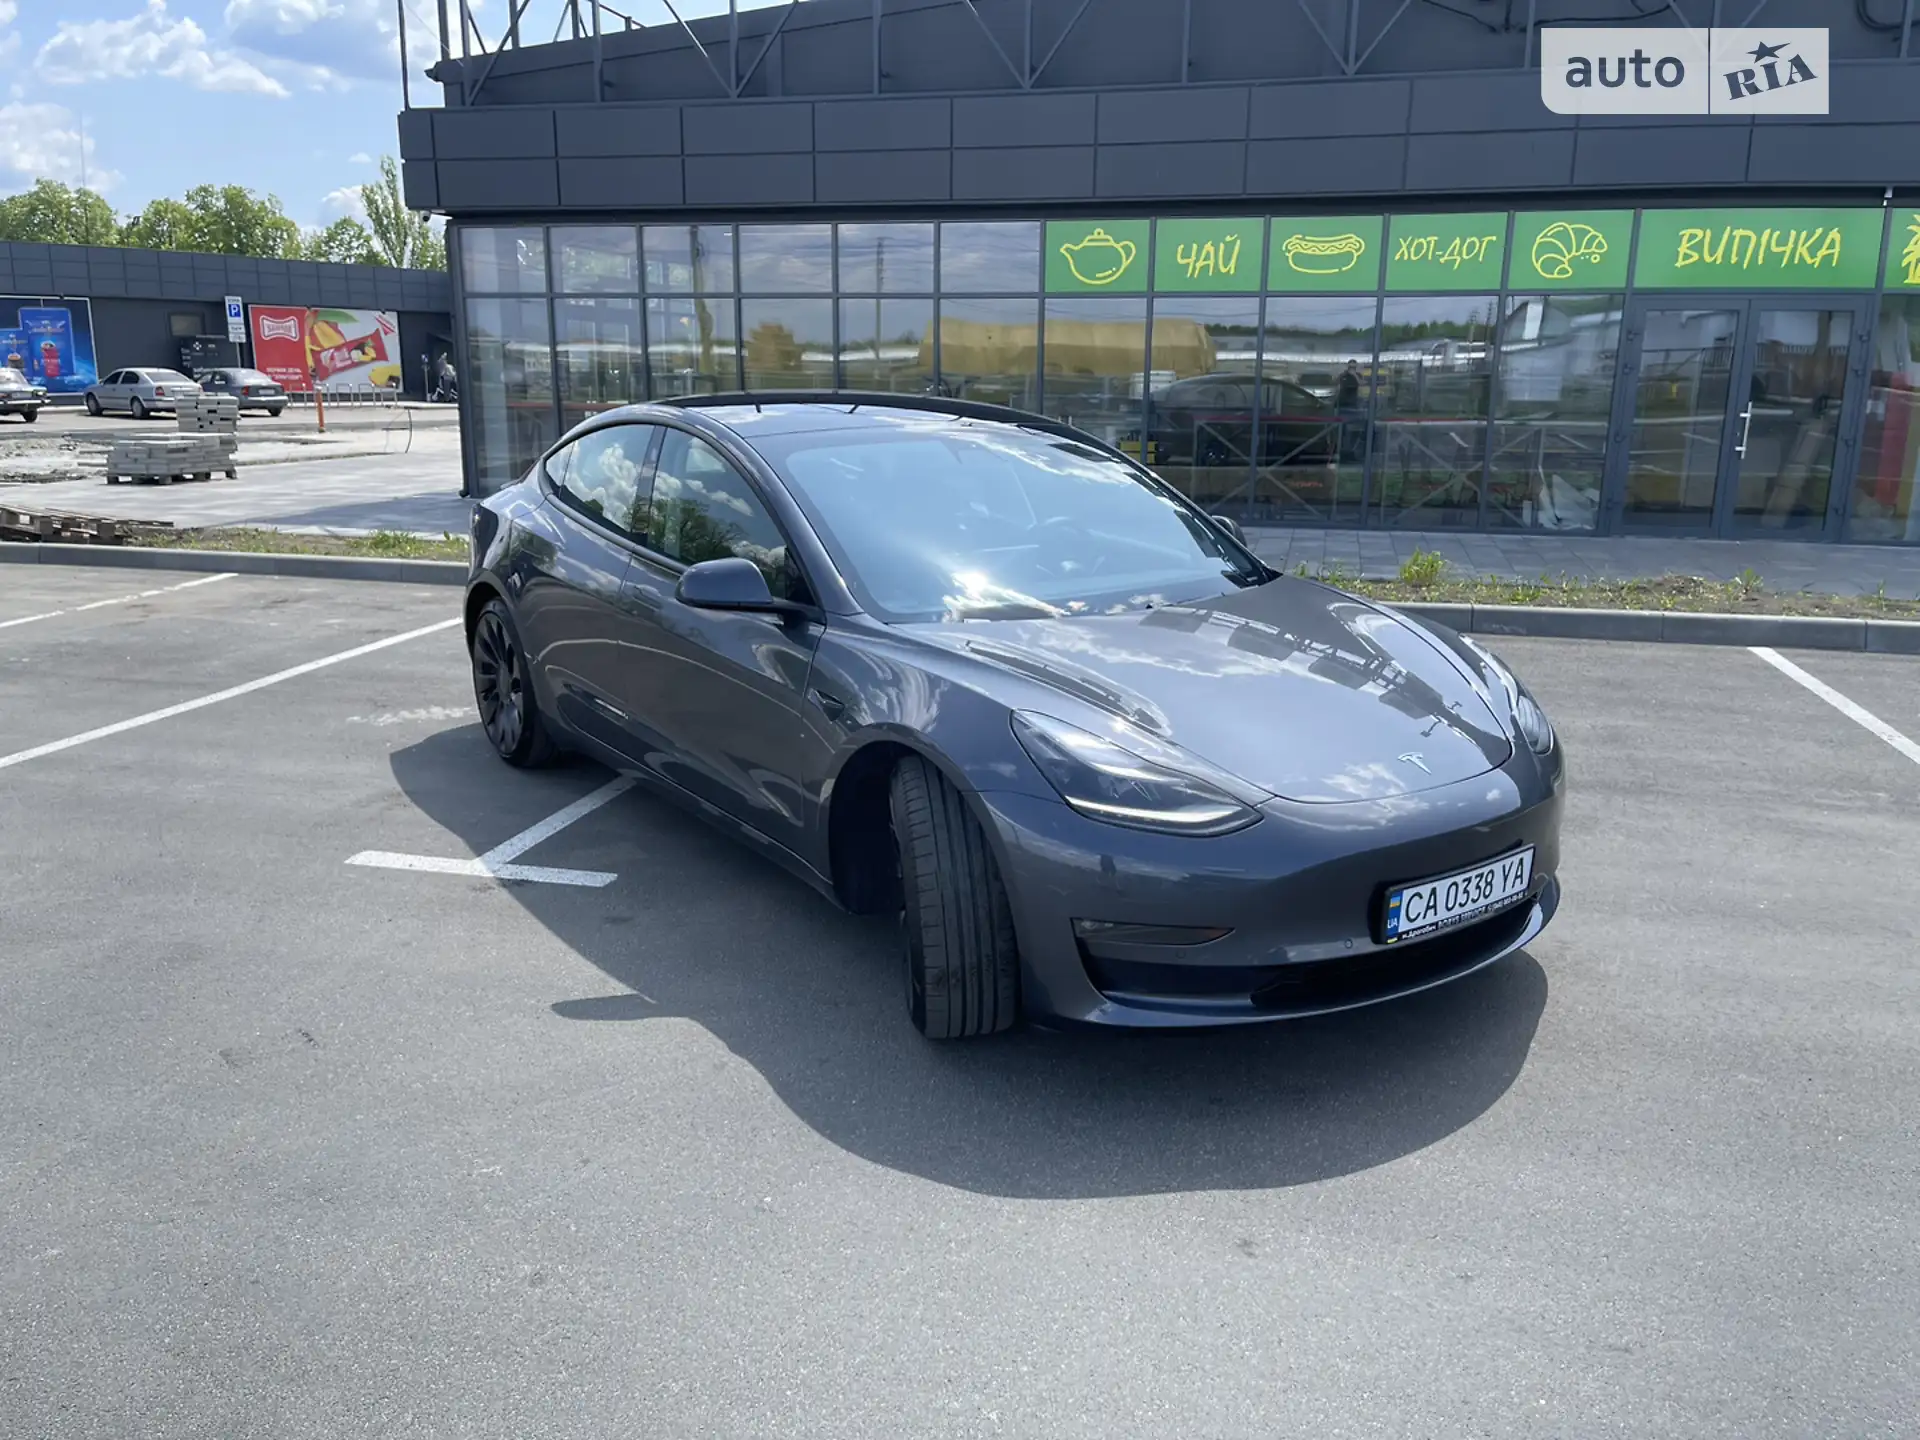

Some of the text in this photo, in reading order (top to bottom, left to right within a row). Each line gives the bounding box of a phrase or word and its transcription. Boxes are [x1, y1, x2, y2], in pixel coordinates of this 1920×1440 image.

[1176, 233, 1241, 278] ЧАЙ
[1394, 235, 1497, 271] ХОТ-ДОГ
[1674, 226, 1841, 270] ВИПІЧКА
[1405, 886, 1438, 923] CA
[1445, 869, 1495, 912] 0338
[1501, 857, 1525, 893] YA
[1387, 917, 1398, 929] UA
